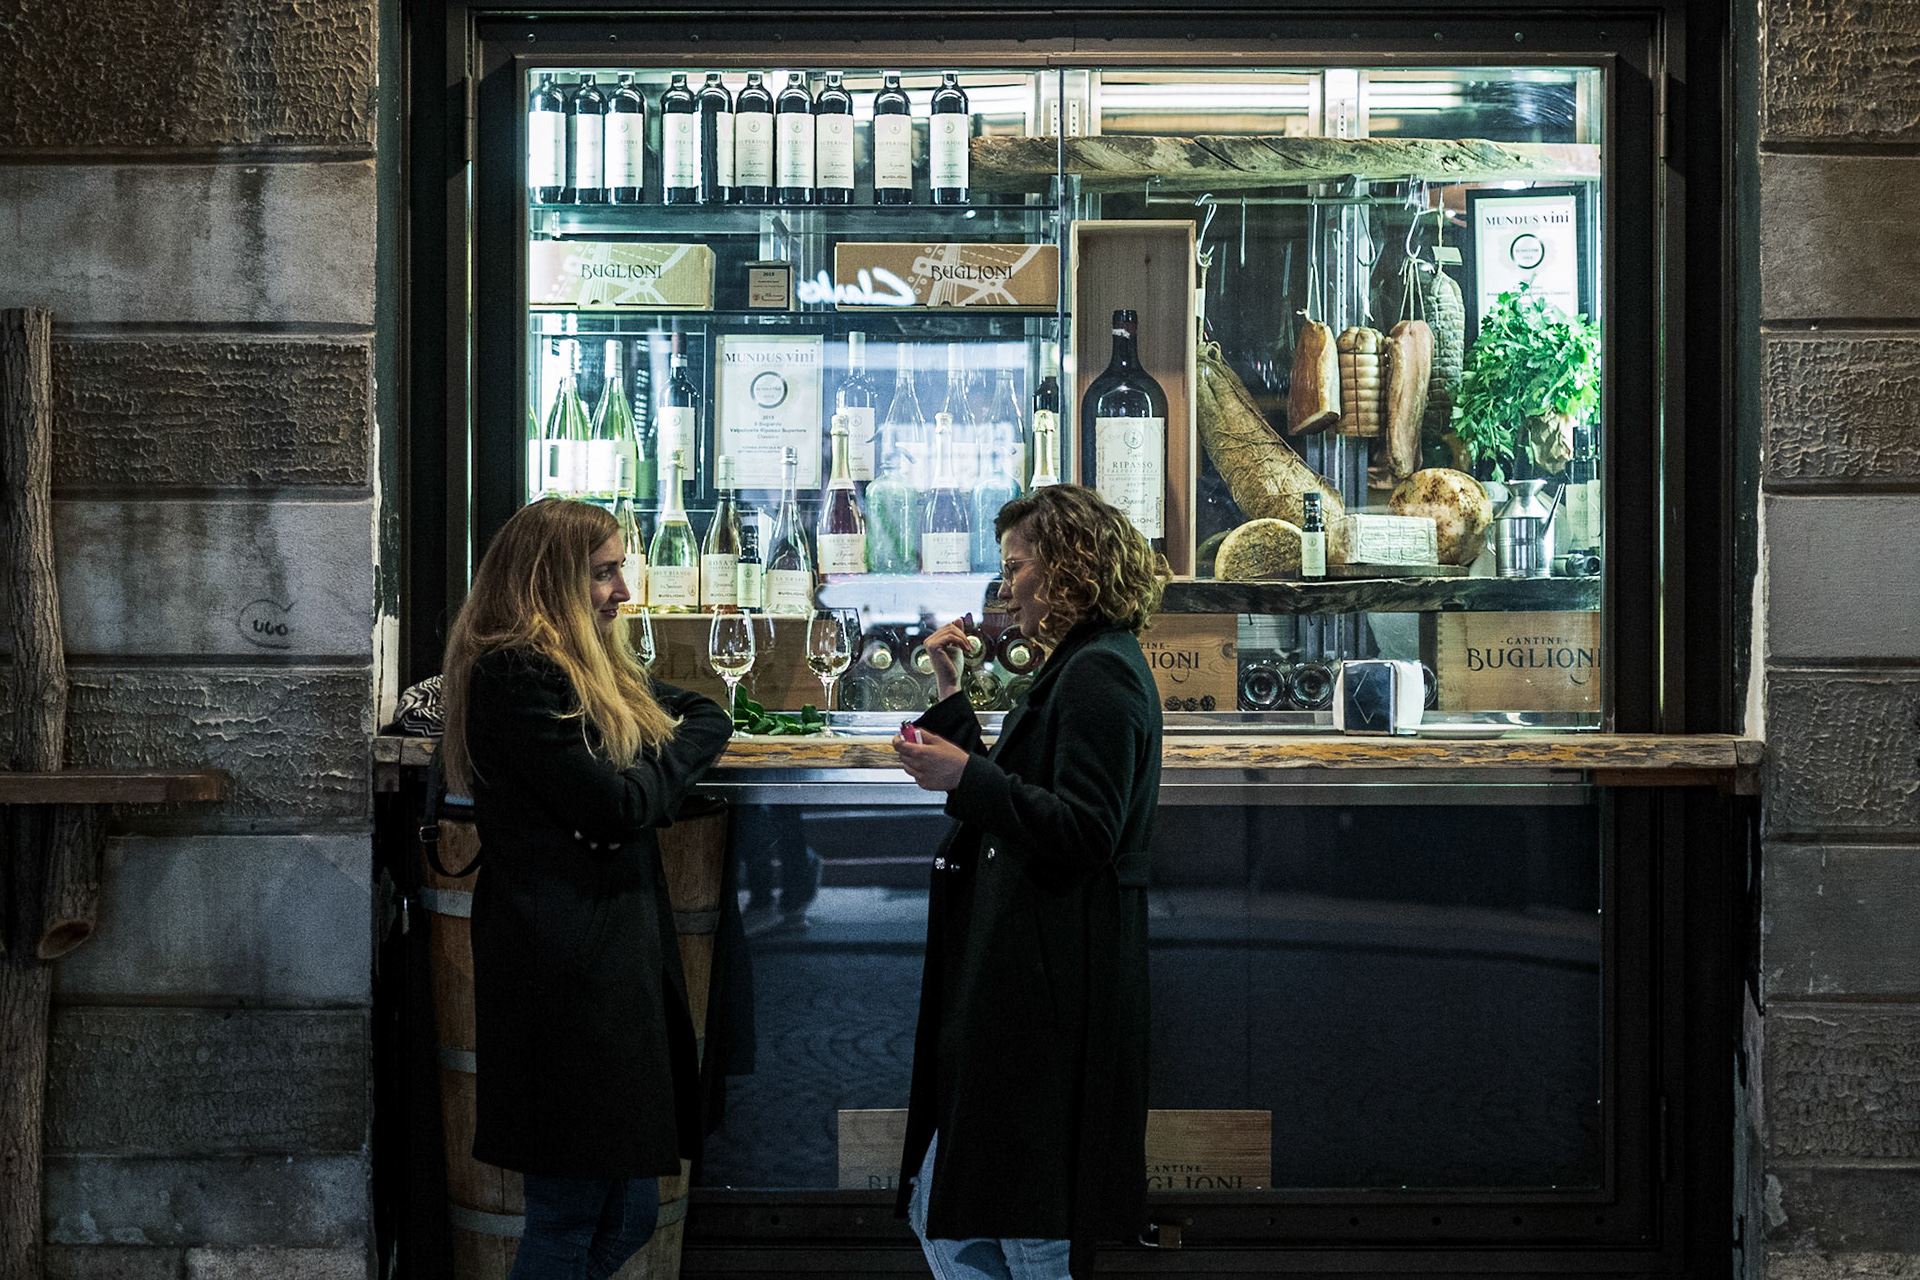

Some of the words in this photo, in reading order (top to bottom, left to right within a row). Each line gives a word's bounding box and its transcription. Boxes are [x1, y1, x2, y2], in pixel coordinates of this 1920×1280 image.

[1486, 216, 1539, 225] MUNDUS
[1543, 210, 1569, 223] vini
[581, 264, 662, 279] BUGLIONI
[931, 265, 1013, 280] BUGLIONI
[725, 353, 782, 362] MUNDUS
[786, 348, 814, 362] vini
[1112, 461, 1153, 469] RIPASSO
[1506, 637, 1562, 645] CANTINE
[1150, 651, 1199, 683] IONI
